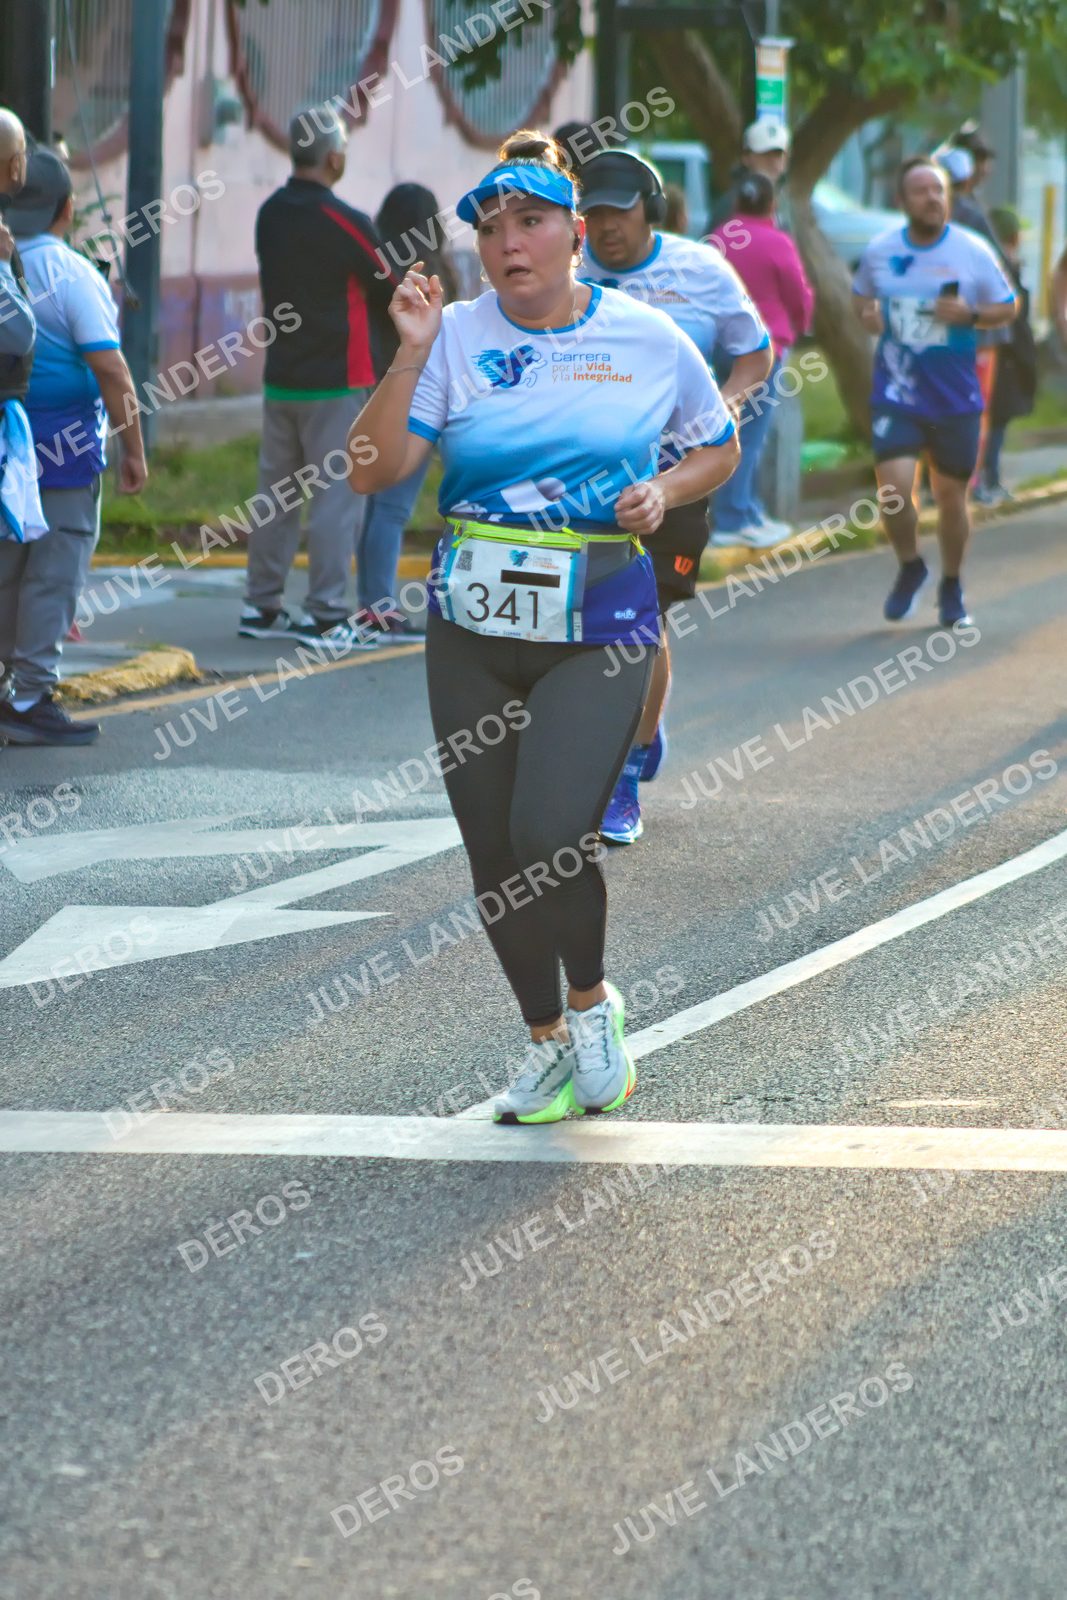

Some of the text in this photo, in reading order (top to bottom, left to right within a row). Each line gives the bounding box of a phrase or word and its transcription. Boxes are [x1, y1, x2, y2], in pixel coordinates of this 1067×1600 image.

[551, 352, 611, 362] Carrera
[552, 362, 612, 373] por la Vida
[560, 372, 570, 381] la
[573, 371, 633, 383] Integridad
[466, 581, 538, 637] 341
